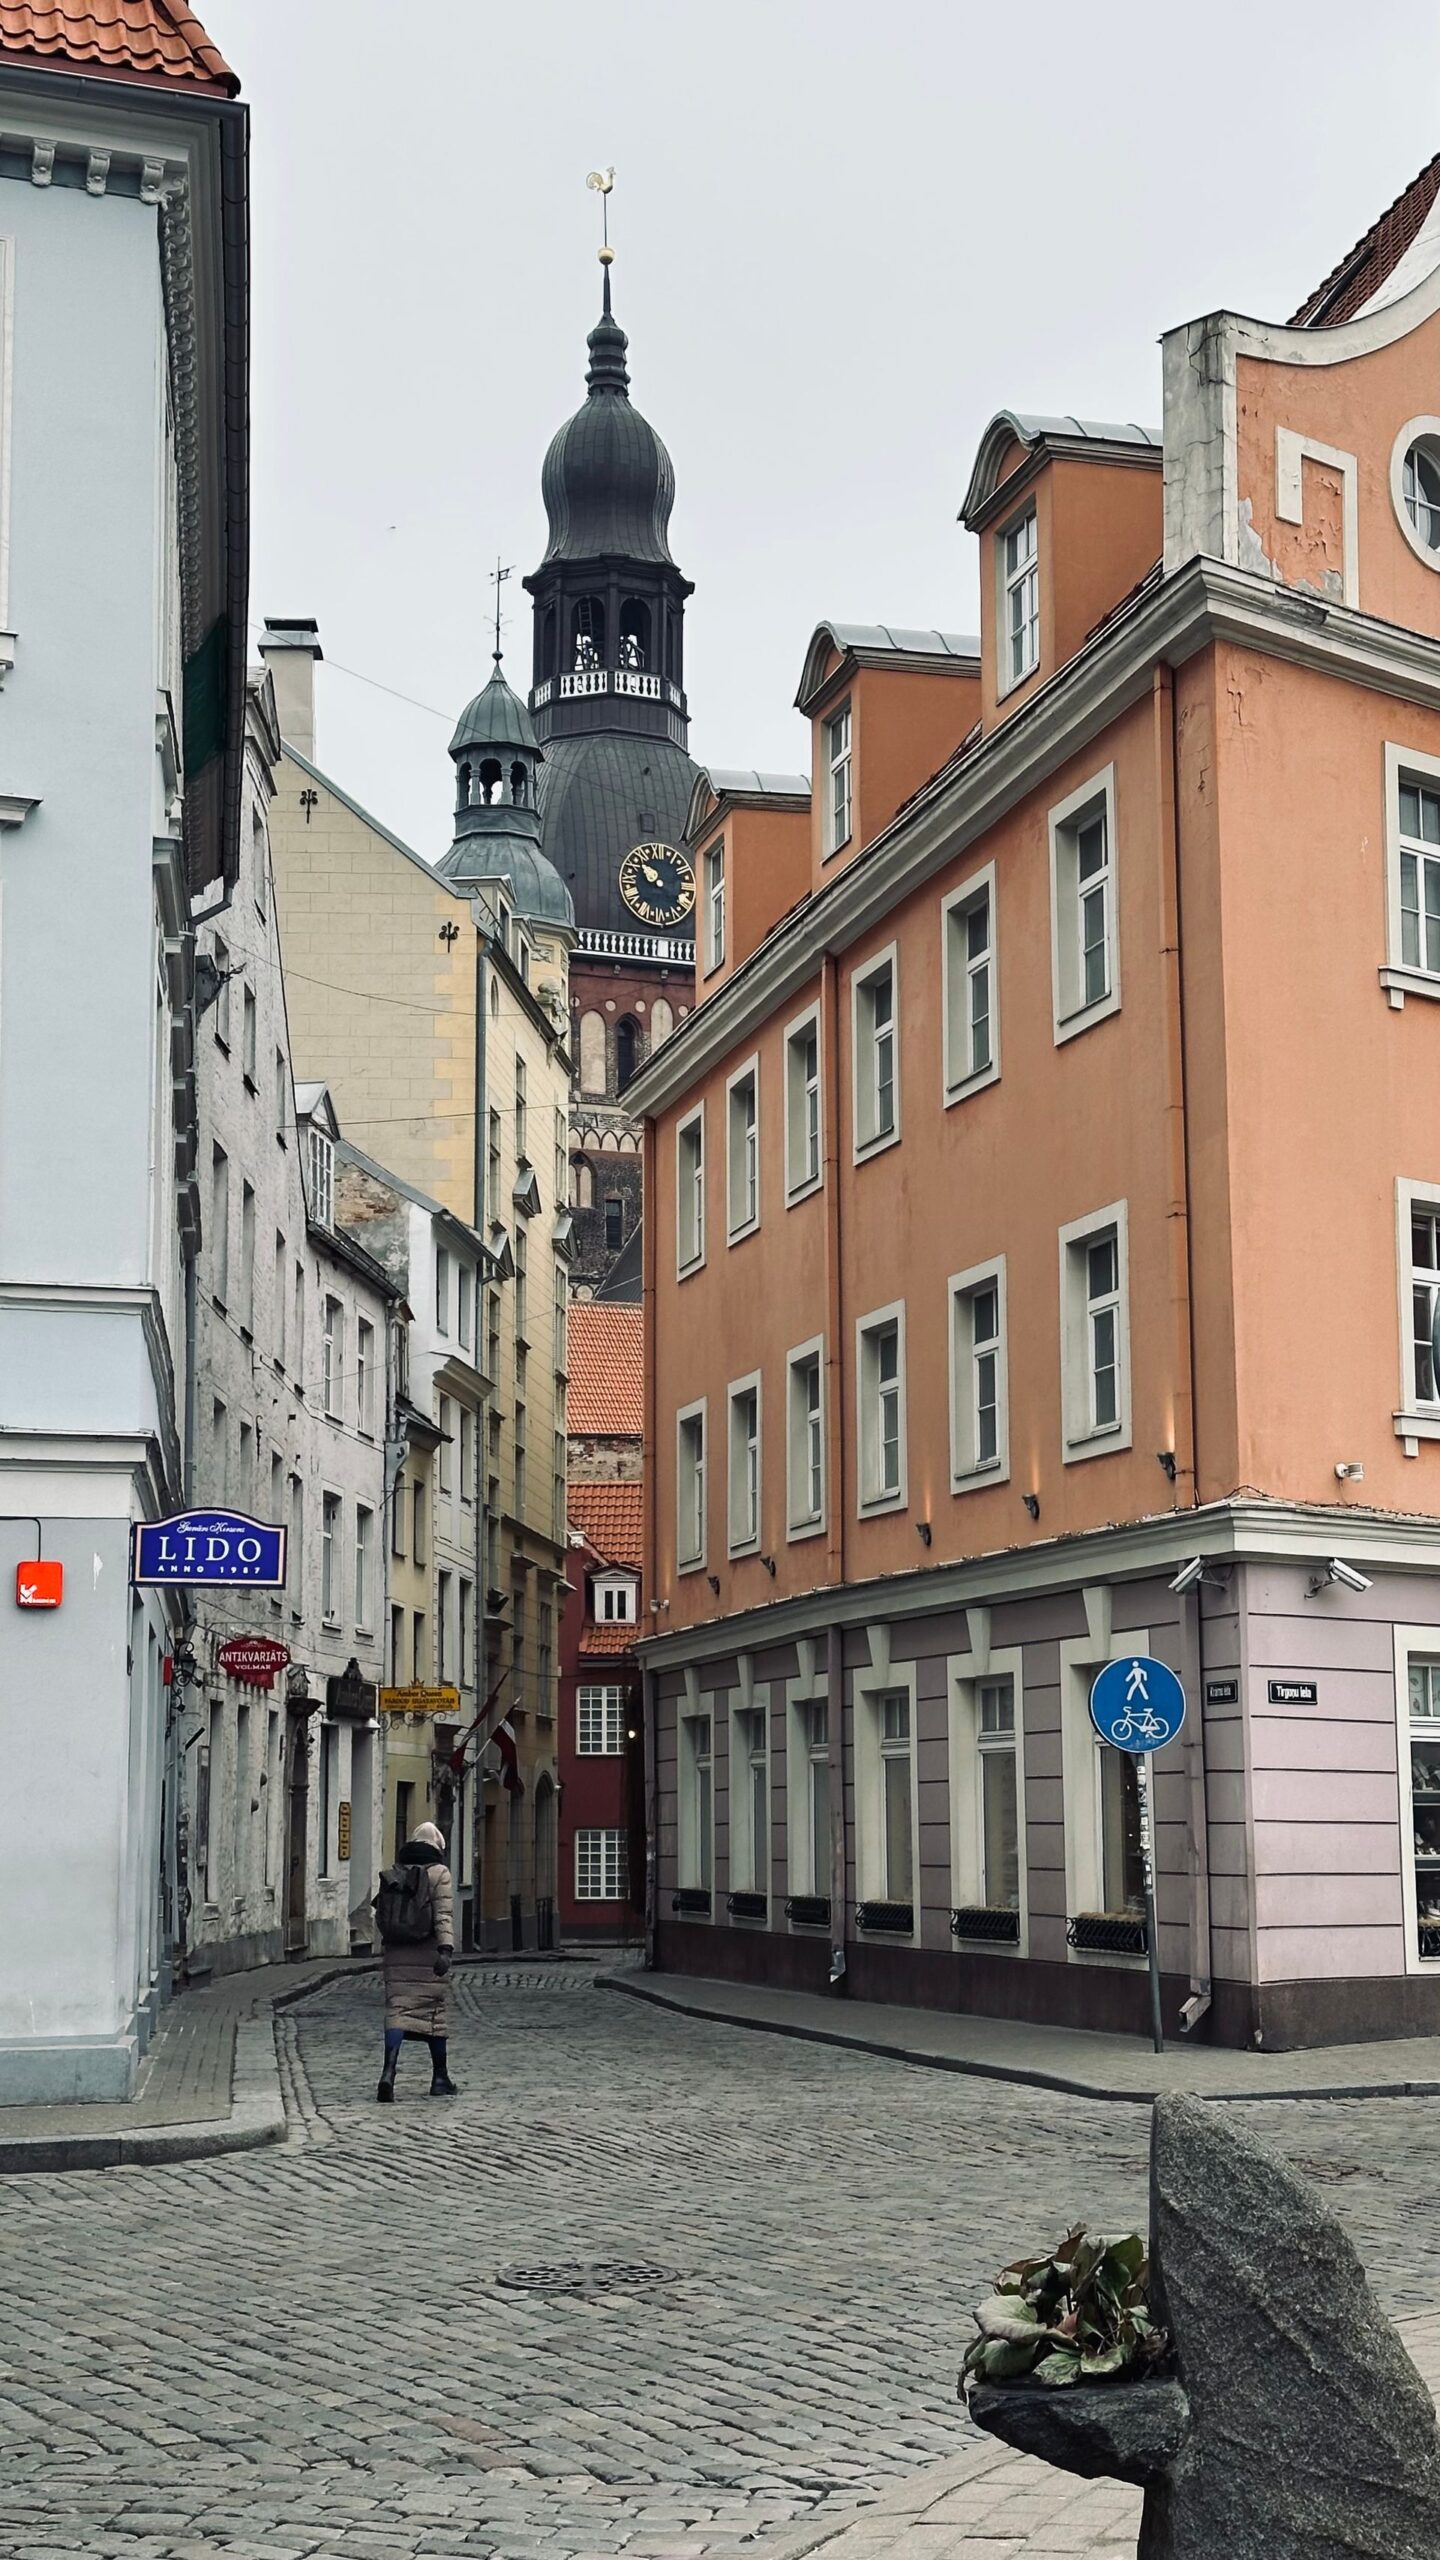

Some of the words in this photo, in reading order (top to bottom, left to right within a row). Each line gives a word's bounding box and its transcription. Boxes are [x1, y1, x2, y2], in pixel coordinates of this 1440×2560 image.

[158, 1536, 262, 1562] LIDO
[157, 1565, 205, 1573] ANNO
[219, 1566, 261, 1574] 1987
[219, 1650, 288, 1662] ANTIKVARIĀTS
